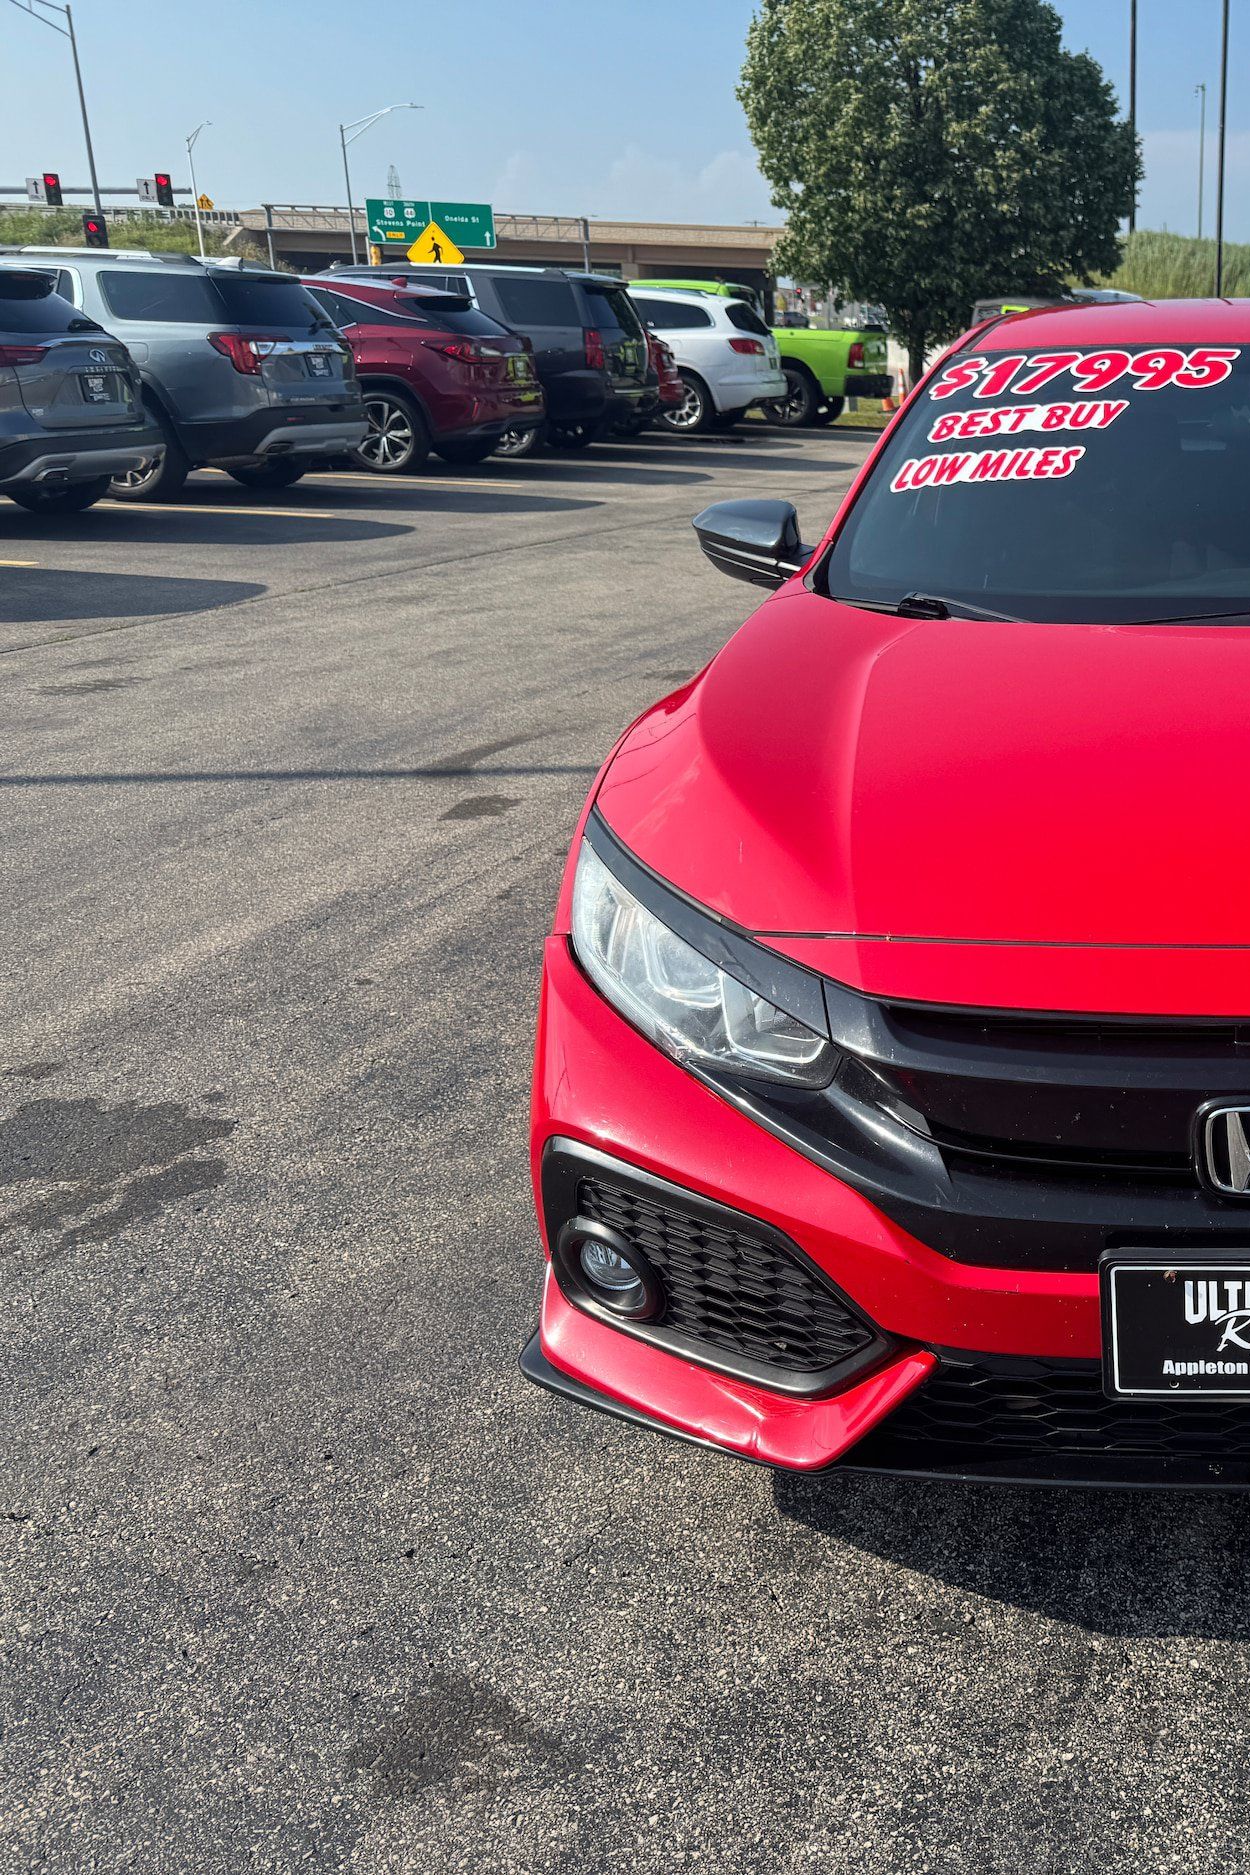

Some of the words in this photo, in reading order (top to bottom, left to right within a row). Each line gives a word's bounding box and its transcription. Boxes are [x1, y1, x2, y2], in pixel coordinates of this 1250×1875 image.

[376, 219, 404, 227] Stevens
[406, 219, 426, 228] Point
[444, 215, 469, 223] Oneida
[470, 216, 480, 224] St
[929, 349, 1241, 400] $17995
[928, 405, 1038, 442] BEST
[1040, 400, 1130, 430] BUY
[890, 453, 972, 492] LOW
[969, 447, 1086, 481] MILES
[1162, 1359, 1249, 1376] Appleton
